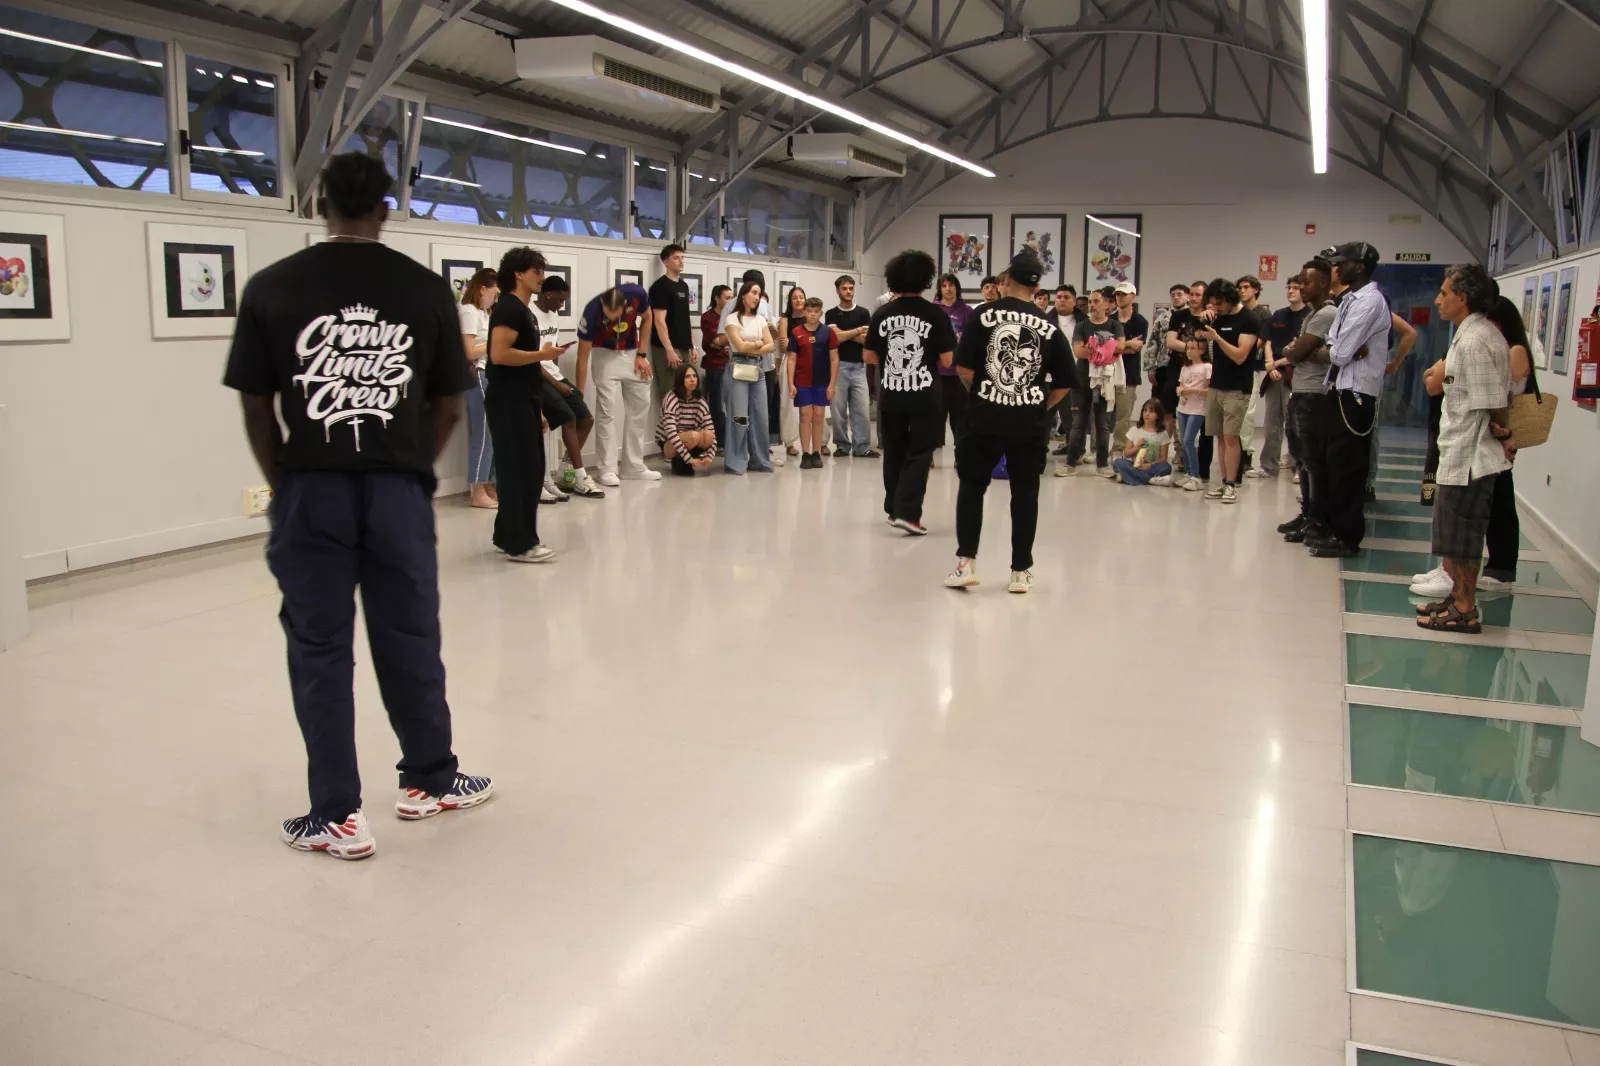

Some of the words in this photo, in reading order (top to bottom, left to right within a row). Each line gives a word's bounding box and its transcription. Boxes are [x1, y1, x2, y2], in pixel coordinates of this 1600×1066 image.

[1399, 253, 1428, 261] SALIDA
[295, 314, 414, 360] Crown
[292, 345, 413, 386] Limits
[307, 379, 399, 420] Crew
[977, 380, 1045, 407] Limits
